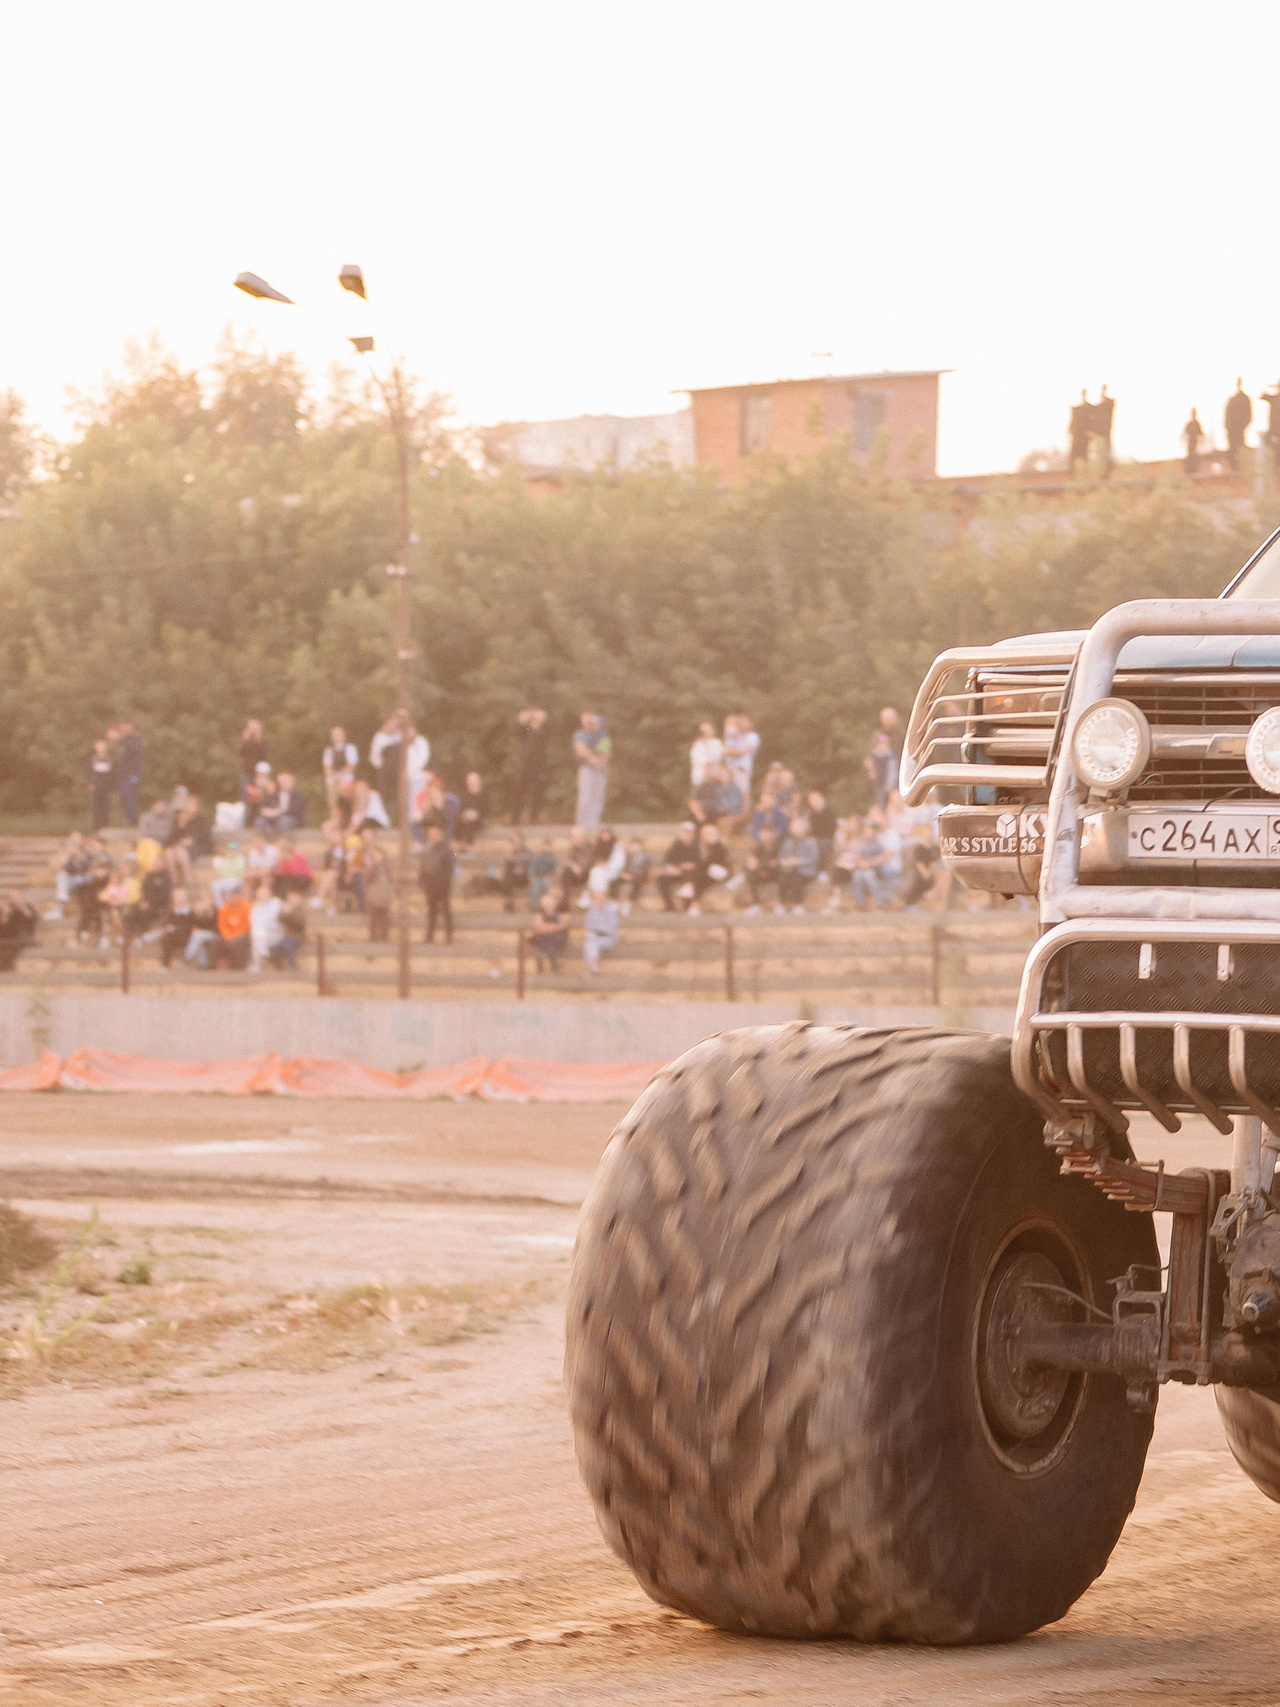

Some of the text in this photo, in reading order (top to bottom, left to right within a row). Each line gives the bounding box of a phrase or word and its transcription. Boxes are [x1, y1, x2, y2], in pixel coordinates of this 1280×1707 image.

[941, 836, 1037, 854] AR'S STYLE 56
